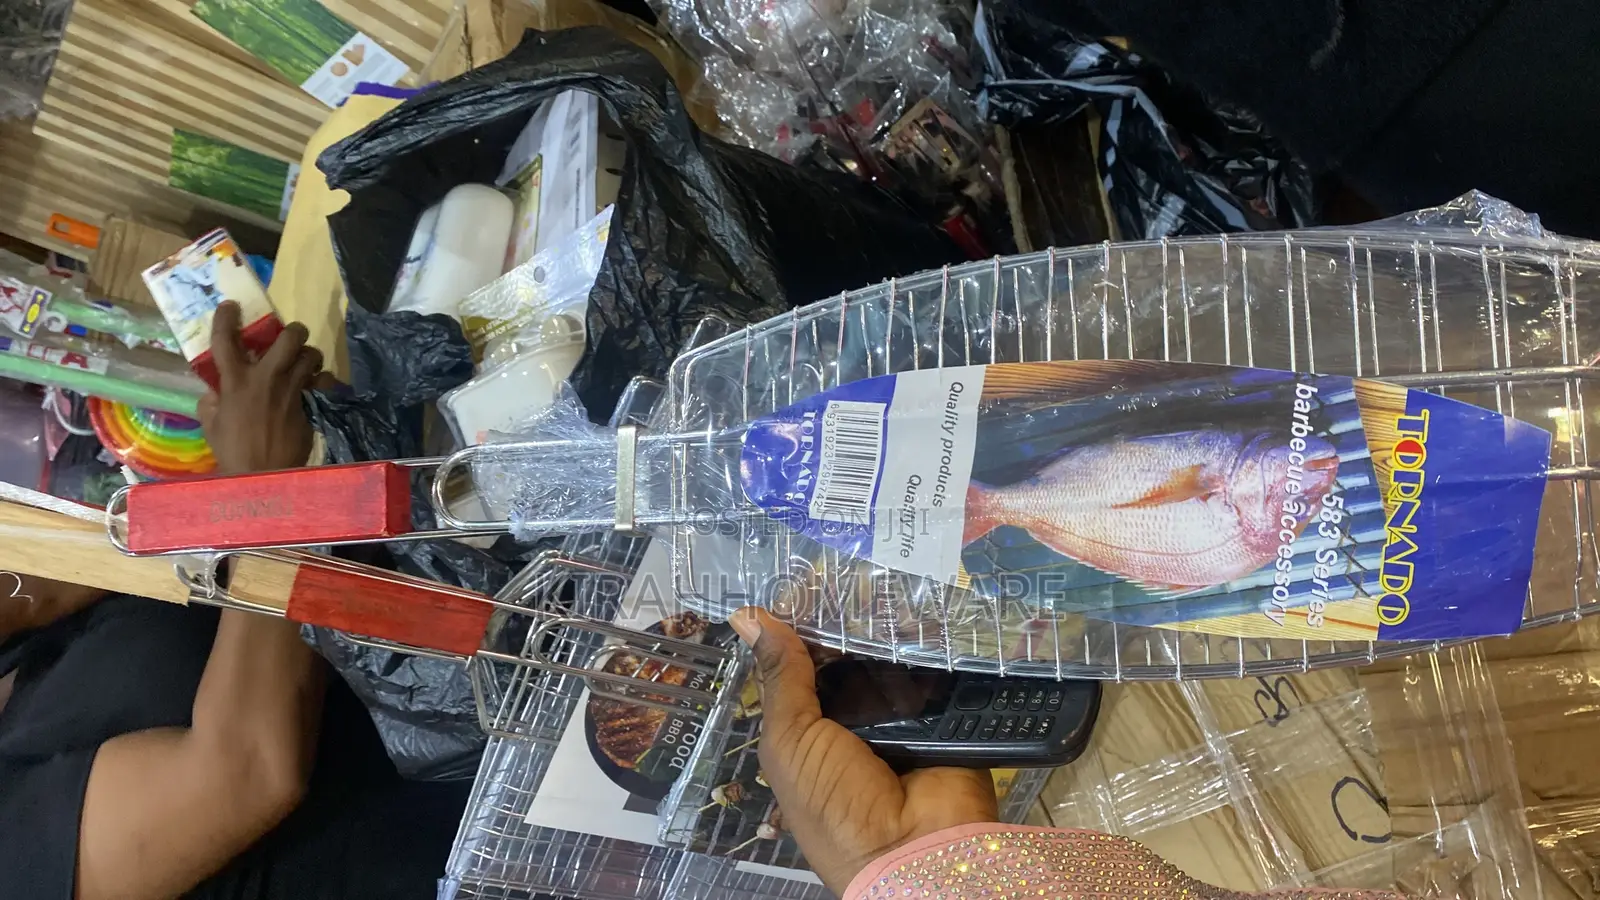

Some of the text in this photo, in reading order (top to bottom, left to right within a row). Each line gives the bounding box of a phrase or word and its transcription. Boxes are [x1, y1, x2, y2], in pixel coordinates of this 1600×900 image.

[792, 411, 817, 505] TORNADO
[932, 381, 964, 508] Quality products
[1264, 383, 1318, 627] barbecue accessory
[900, 474, 922, 558] Quality life
[1306, 493, 1345, 628] 583 Series
[1377, 409, 1430, 626] TORNADO
[661, 718, 684, 744] BBQ
